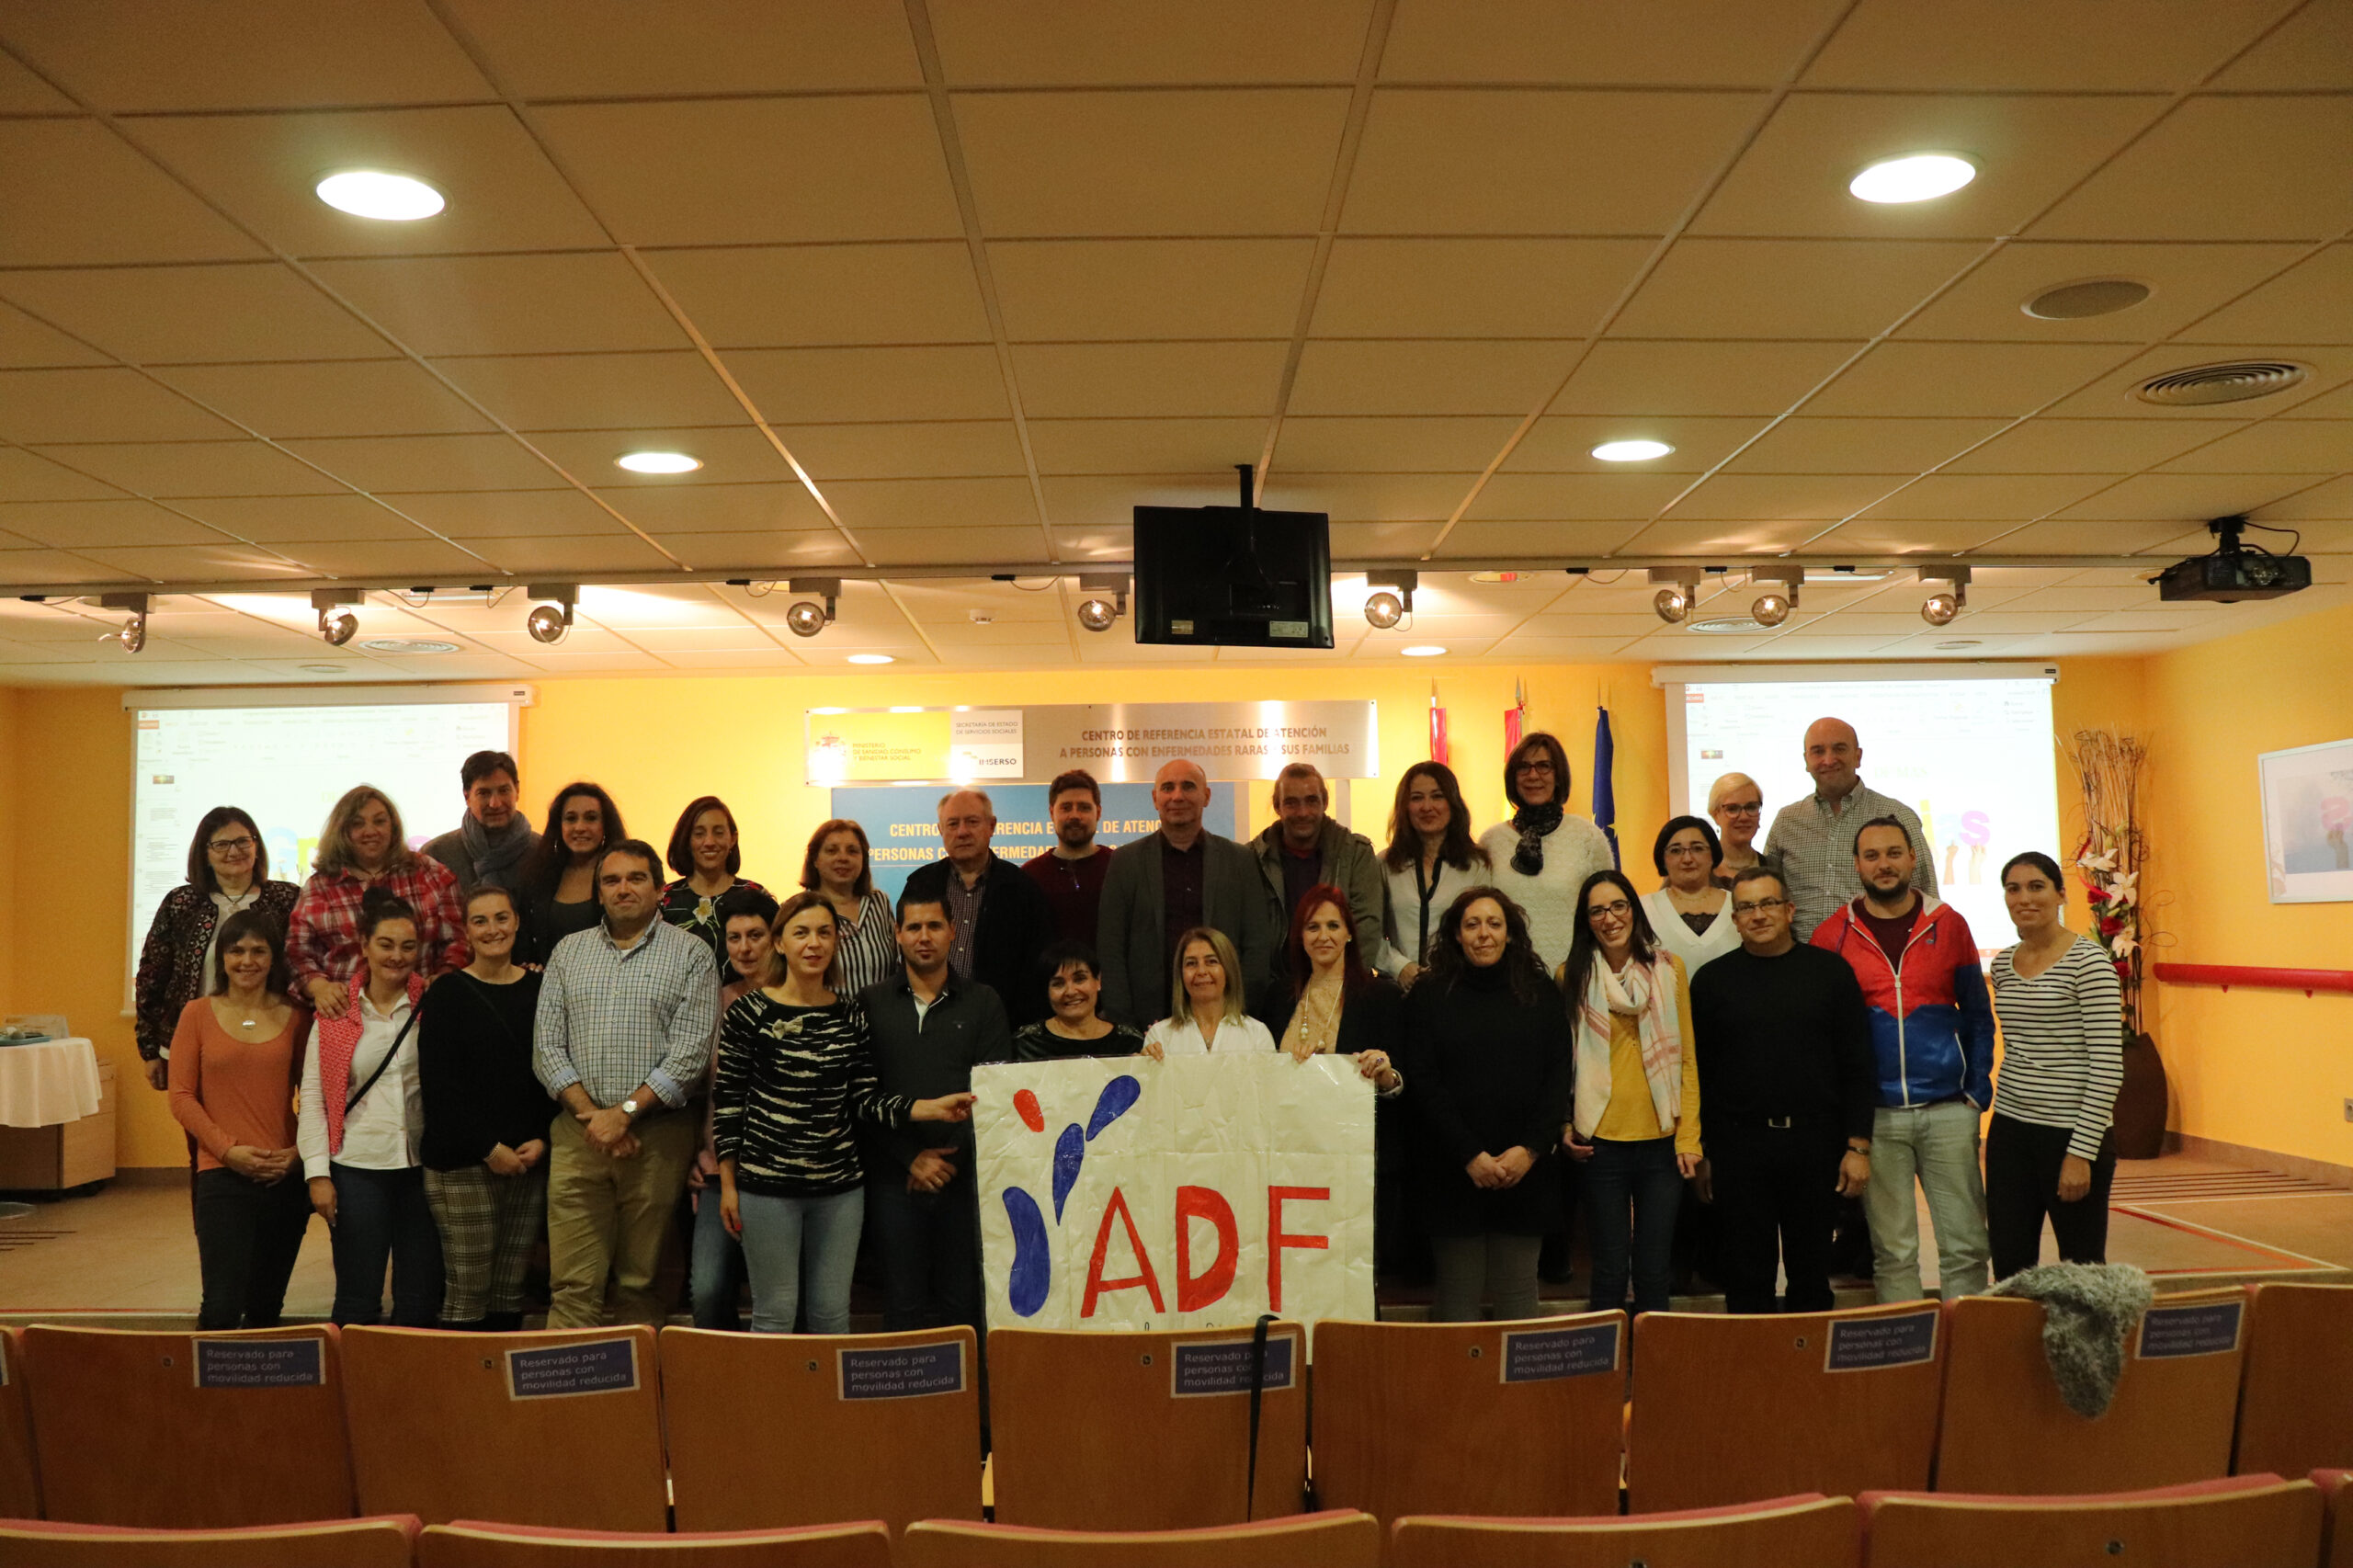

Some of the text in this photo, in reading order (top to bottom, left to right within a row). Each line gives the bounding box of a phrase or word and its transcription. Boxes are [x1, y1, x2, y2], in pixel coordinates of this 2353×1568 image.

[1081, 725, 1327, 741] CENTRO DE REFERENCIA ESTATAL DE ATENCIÓN
[1060, 747, 1067, 758] A
[1070, 747, 1123, 758] PERSONAS
[1126, 746, 1149, 757] CON
[1152, 744, 1232, 757] ENFERMEDADES
[1235, 744, 1268, 756] RARAS
[1281, 744, 1300, 755] SUS
[1302, 744, 1349, 755] FAMILIAS
[890, 823, 940, 837] CENTRO
[993, 822, 1043, 835] RENCIA
[1103, 820, 1120, 834] DE
[1123, 819, 1162, 834] ATENC
[1080, 1185, 1331, 1318] ADF
[1839, 1324, 1915, 1338] Reservado para
[1515, 1336, 1596, 1351] Reservado para
[1838, 1337, 1903, 1351] personas con
[207, 1349, 294, 1359] Reservado para
[520, 1352, 608, 1369] Reservado para
[1184, 1352, 1241, 1363] Reservado
[1514, 1349, 1583, 1364] personas con
[1837, 1346, 1927, 1361] movilidad reducida
[207, 1363, 257, 1371] personas
[850, 1355, 937, 1368] Reservado para
[1514, 1358, 1609, 1374] movilidad reducida
[207, 1372, 313, 1383] movilidad reducida
[521, 1366, 595, 1381] personas con
[851, 1369, 924, 1382] personas con
[1184, 1370, 1285, 1387] movilidad recida
[1185, 1365, 1252, 1377] personas co
[522, 1373, 627, 1390] movilidad reducida
[851, 1376, 955, 1392] movilidad reducida
